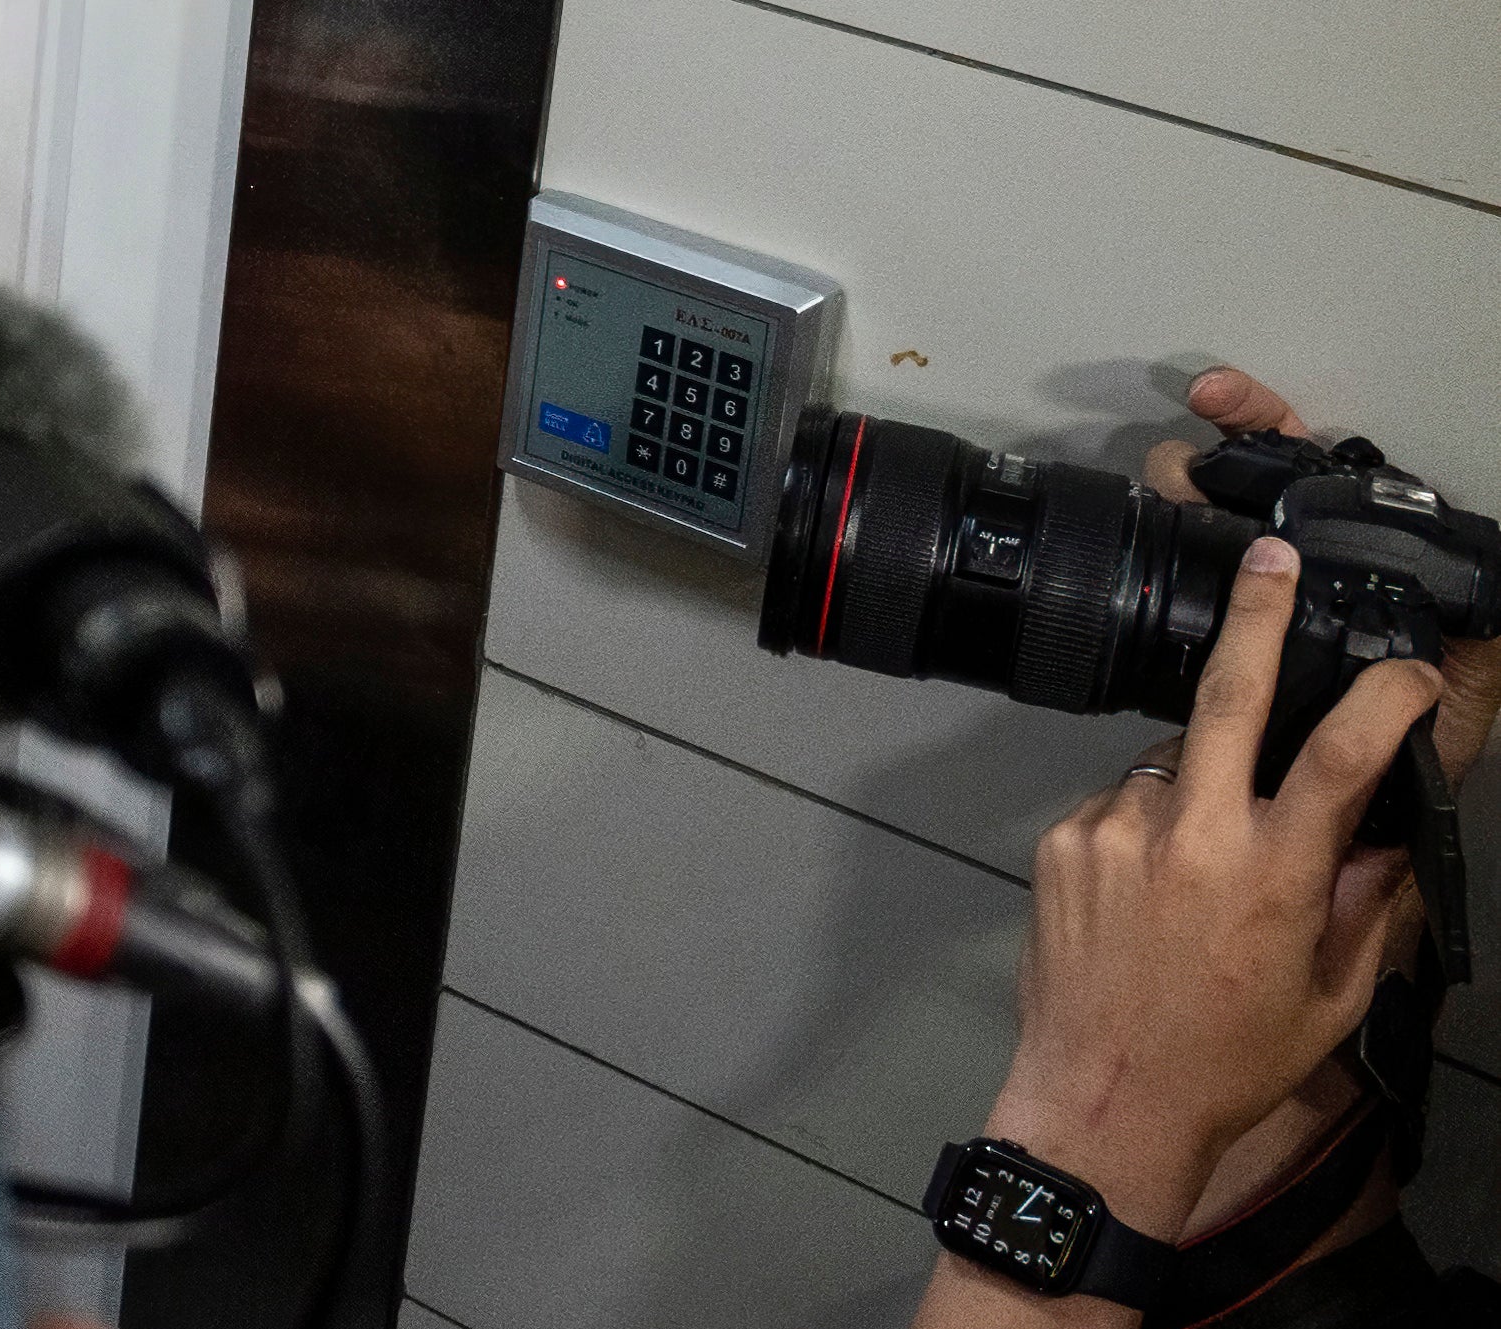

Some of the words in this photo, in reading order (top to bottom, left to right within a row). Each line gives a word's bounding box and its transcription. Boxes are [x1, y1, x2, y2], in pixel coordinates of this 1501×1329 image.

[653, 339, 663, 356] 1
[690, 350, 703, 369] 2
[729, 364, 741, 382] 3
[646, 374, 659, 392] 4
[685, 386, 697, 405] 5
[724, 399, 737, 417] 6
[643, 409, 655, 427] 7
[680, 422, 692, 440] 8
[718, 436, 731, 453] 9
[676, 459, 687, 476] 0
[975, 1167, 989, 1178] 1
[998, 1169, 1015, 1184] 2
[1019, 1179, 1035, 1193] 3
[964, 1187, 983, 1208] 12
[954, 1212, 971, 1229] 11
[1057, 1205, 1073, 1220] 5
[972, 1223, 992, 1245] 10
[1049, 1228, 1065, 1244] 6
[993, 1239, 1009, 1254] 9
[1014, 1250, 1031, 1264] 8
[1037, 1253, 1054, 1267] 7
